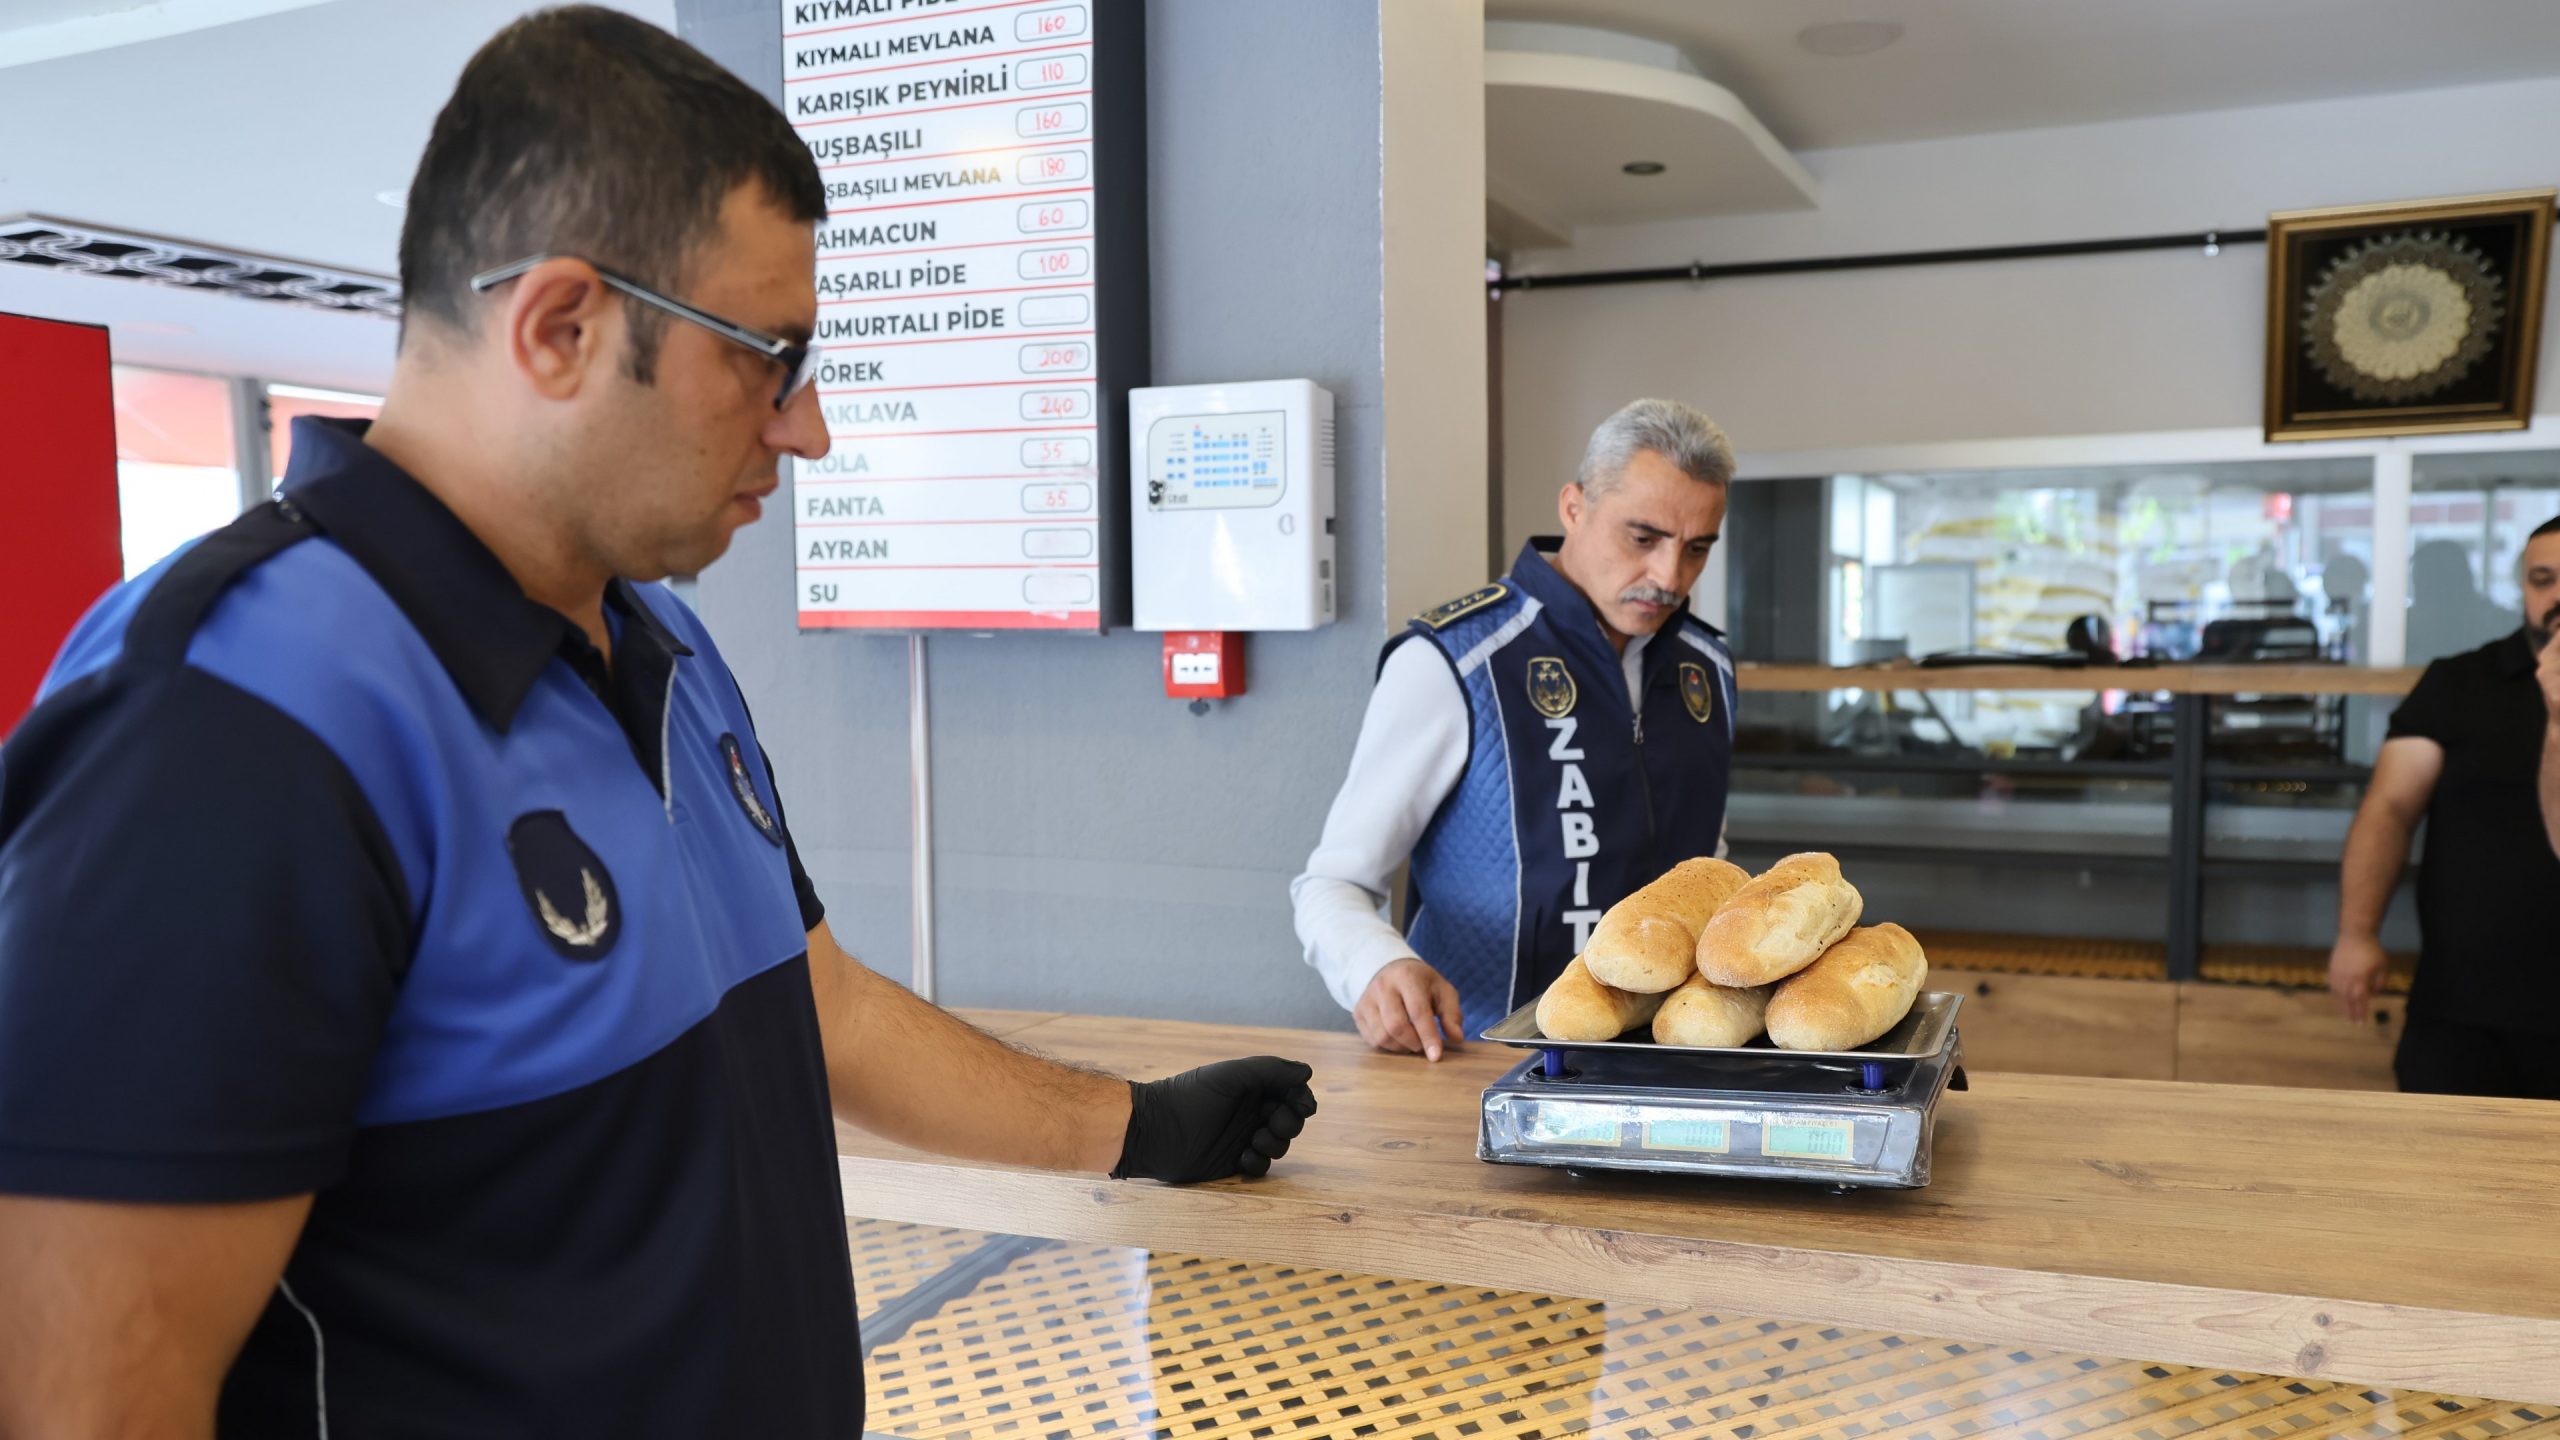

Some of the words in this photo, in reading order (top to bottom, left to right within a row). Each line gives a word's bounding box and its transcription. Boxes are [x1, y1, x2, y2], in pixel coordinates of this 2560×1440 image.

[795, 0, 892, 24] KIYMALI
[1038, 15, 1066, 34] 160
[796, 41, 881, 68] KIYMALI
[888, 26, 995, 56] MEVLANA
[1041, 62, 1064, 82] 110
[797, 86, 889, 115] KARIŞIK
[898, 63, 1008, 103] PEYNİRLİ
[1036, 111, 1062, 131] 160
[807, 128, 922, 165] UŞBAŞILI
[1040, 157, 1066, 178] 180
[825, 177, 897, 204] ŞBAŞILI
[904, 167, 1001, 192] MEVLANA
[1039, 207, 1064, 227] 60
[815, 221, 936, 251] AHMACUN
[1040, 253, 1069, 274] 100
[815, 269, 901, 300] AŞARLI
[910, 259, 966, 287] PİDE
[816, 312, 938, 339] UMURTALI
[947, 302, 1004, 330] PİDE
[822, 401, 918, 424] AKLAVA
[1040, 396, 1074, 419] 240
[808, 496, 884, 517] FANTA
[808, 539, 888, 560] AYRAN
[809, 584, 838, 603] SU
